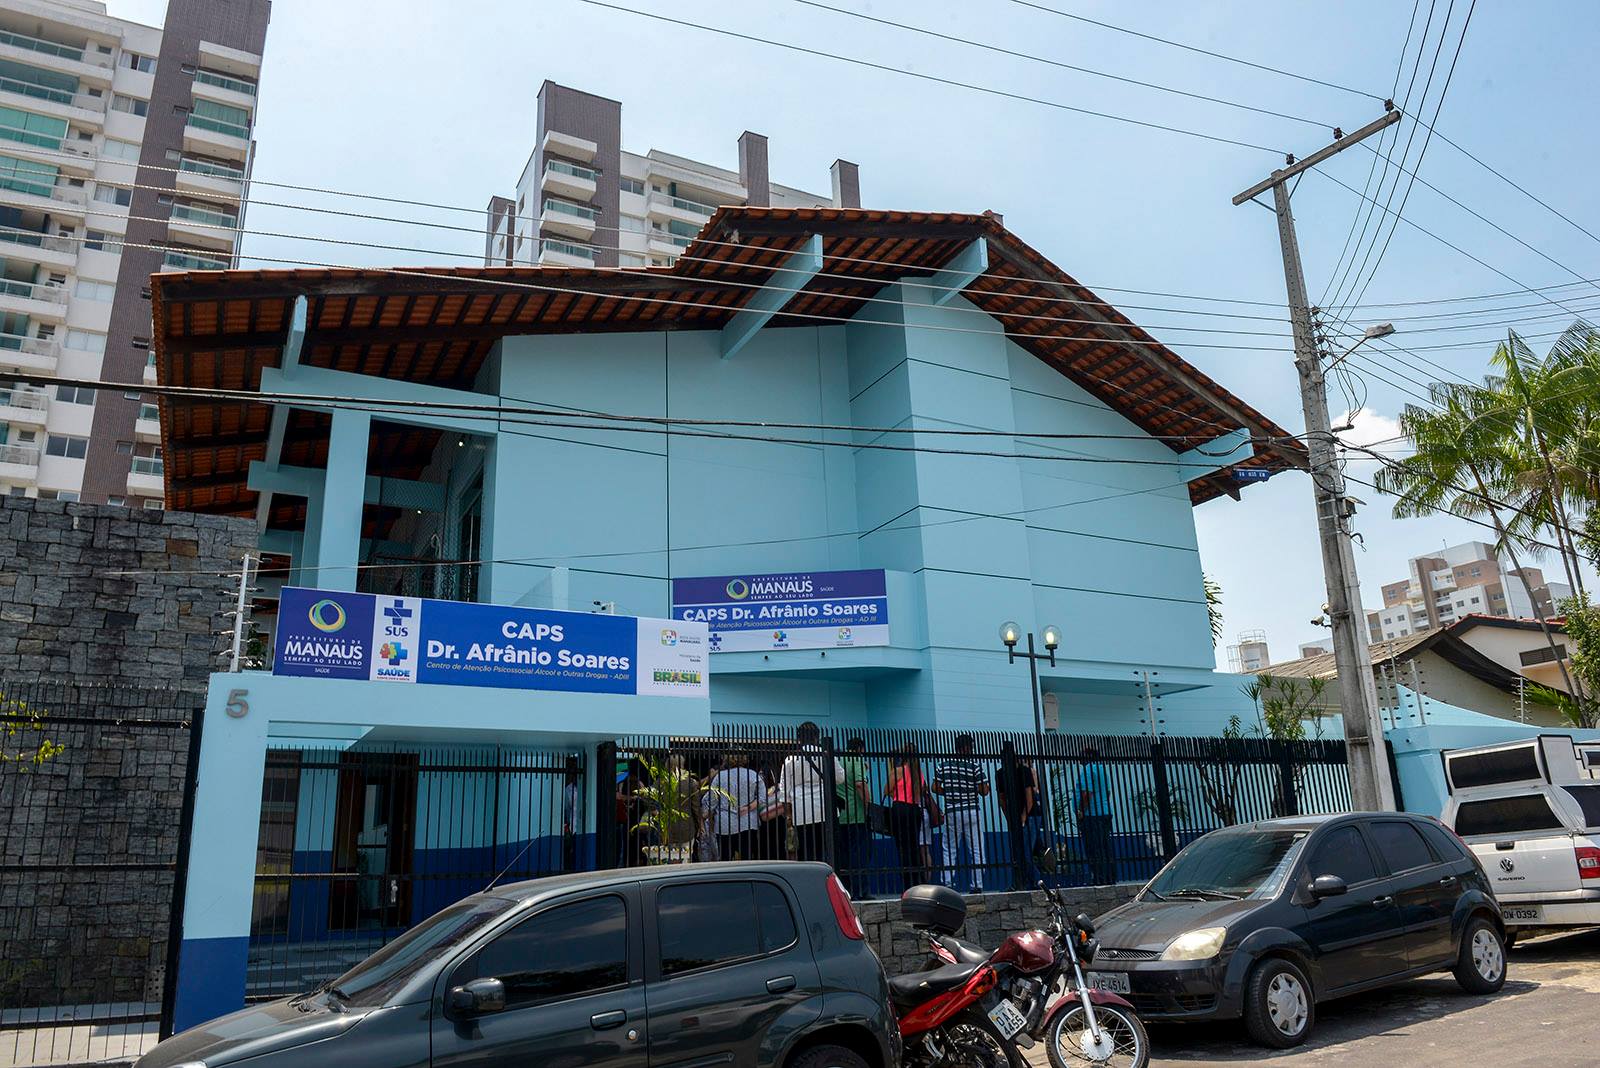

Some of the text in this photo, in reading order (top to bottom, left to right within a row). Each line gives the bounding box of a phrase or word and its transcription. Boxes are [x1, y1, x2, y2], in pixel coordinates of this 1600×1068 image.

[750, 580, 814, 595] MANAUS
[683, 602, 878, 621] CAPS Dr. Afrânio Soares
[808, 617, 830, 625] Outras
[831, 616, 854, 625] Drogas
[385, 626, 409, 637] SUS
[502, 621, 564, 642] CAPS
[284, 641, 363, 660] MANAUS
[427, 640, 630, 671] Dr. Afrânio Soares
[377, 668, 411, 678] SAÚDE
[426, 661, 451, 670] Centro
[462, 664, 492, 673] Atenção
[493, 665, 533, 675] Psicossocial
[534, 667, 556, 676] Álcool
[562, 670, 584, 678] Outras
[585, 671, 609, 680] Drogas
[654, 671, 702, 684] BRASIL
[226, 689, 249, 718] 5
